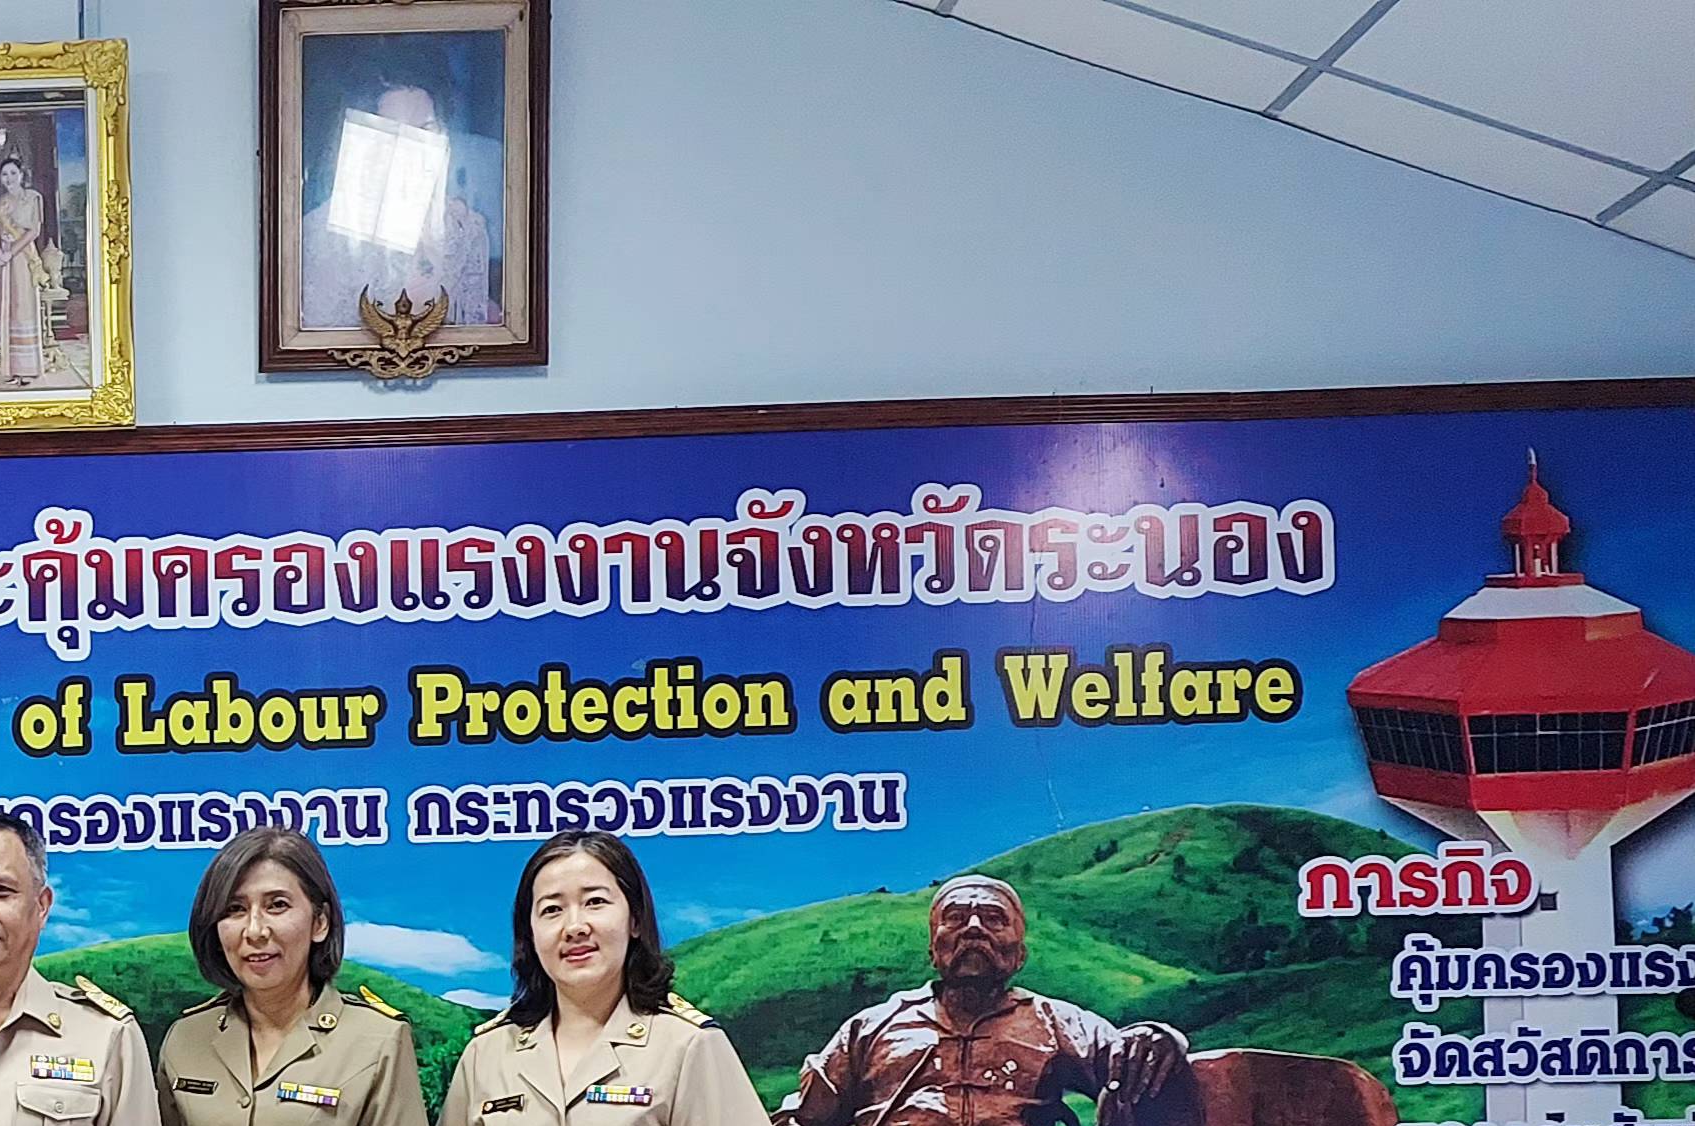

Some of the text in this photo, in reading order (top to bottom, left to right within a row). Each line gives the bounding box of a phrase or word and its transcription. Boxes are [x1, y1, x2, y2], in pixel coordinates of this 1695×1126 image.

[20, 684, 86, 749] of
[122, 678, 379, 746] Labour
[416, 664, 790, 738] Protection
[828, 656, 967, 725] and
[1004, 651, 1295, 720] Welfare
[413, 778, 902, 836] กระทรวงแรงงาน
[1304, 847, 1533, 910] ภารกิจ
